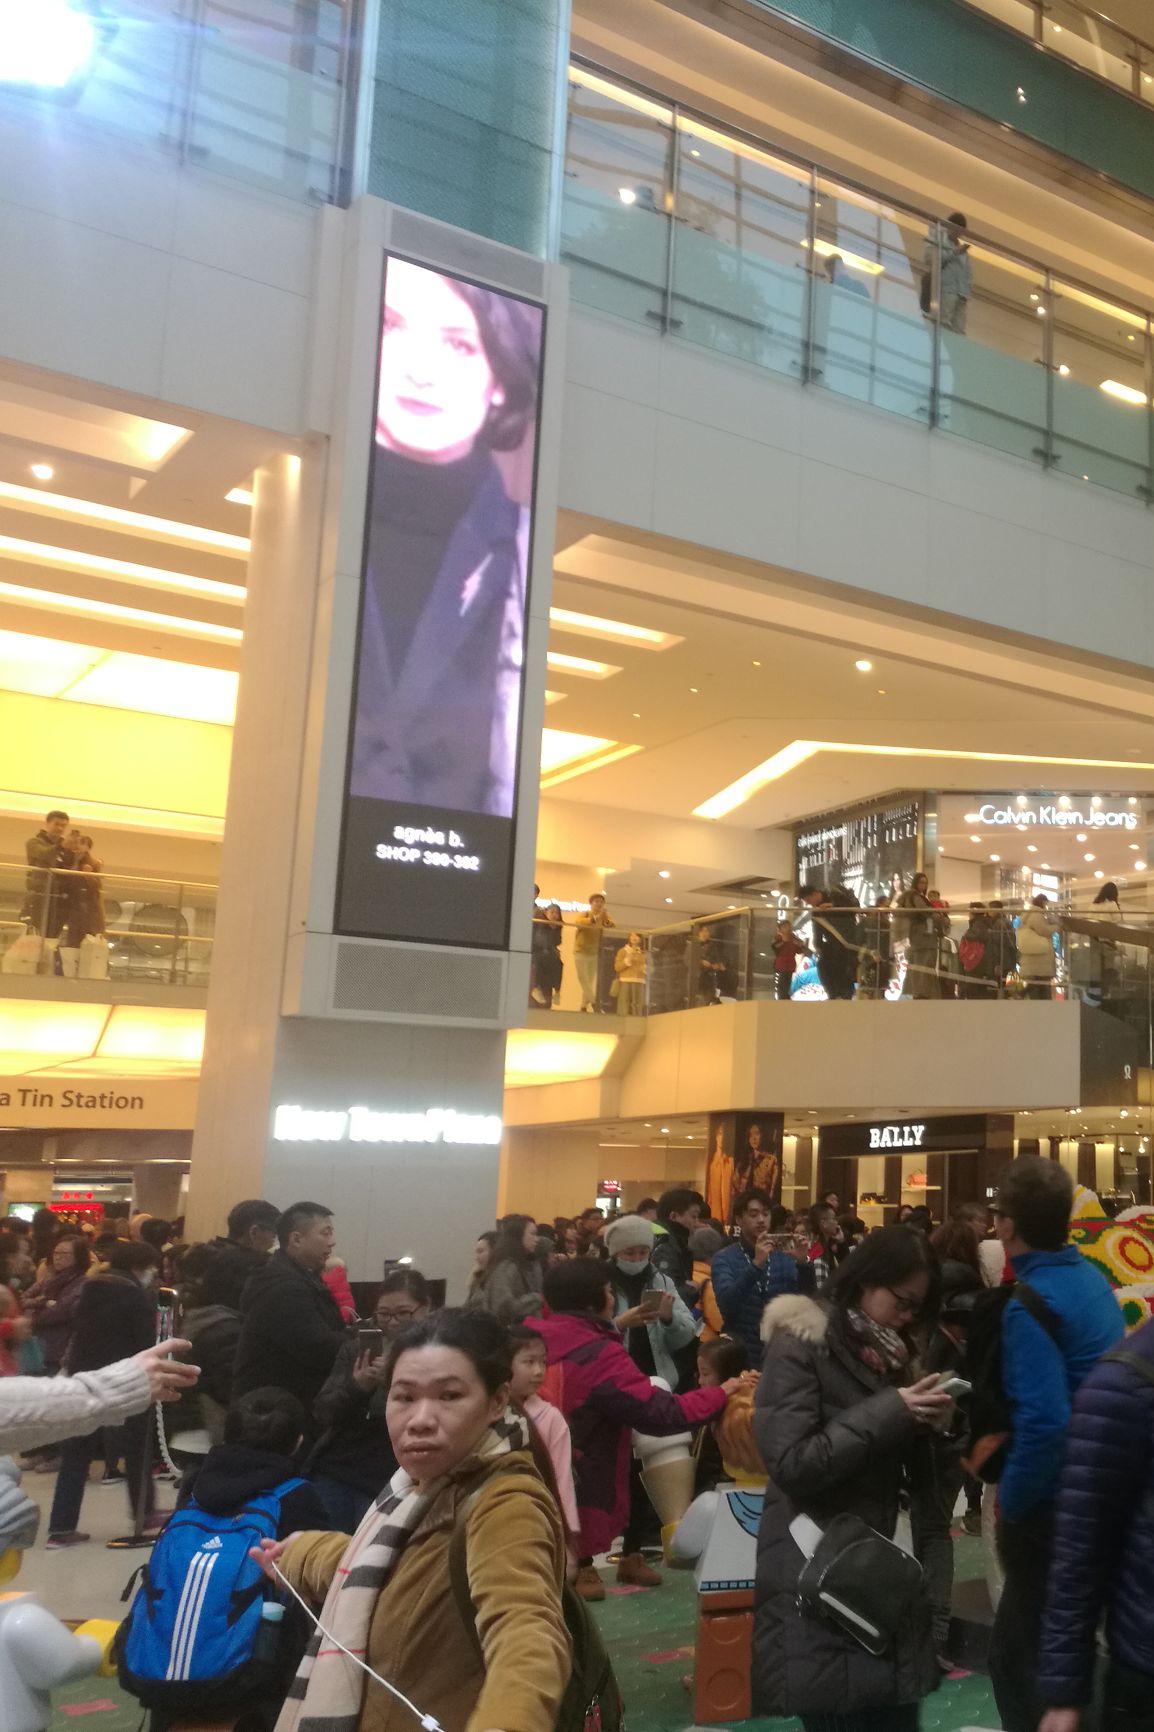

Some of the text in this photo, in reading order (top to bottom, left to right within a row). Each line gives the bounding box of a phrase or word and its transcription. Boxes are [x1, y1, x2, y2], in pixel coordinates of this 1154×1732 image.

[979, 805, 1137, 826] Calvin Klein Jeans
[376, 844, 421, 862] SHOP
[17, 1088, 54, 1107] Tin
[61, 1089, 144, 1109] Station
[869, 1125, 925, 1148] BALLY
